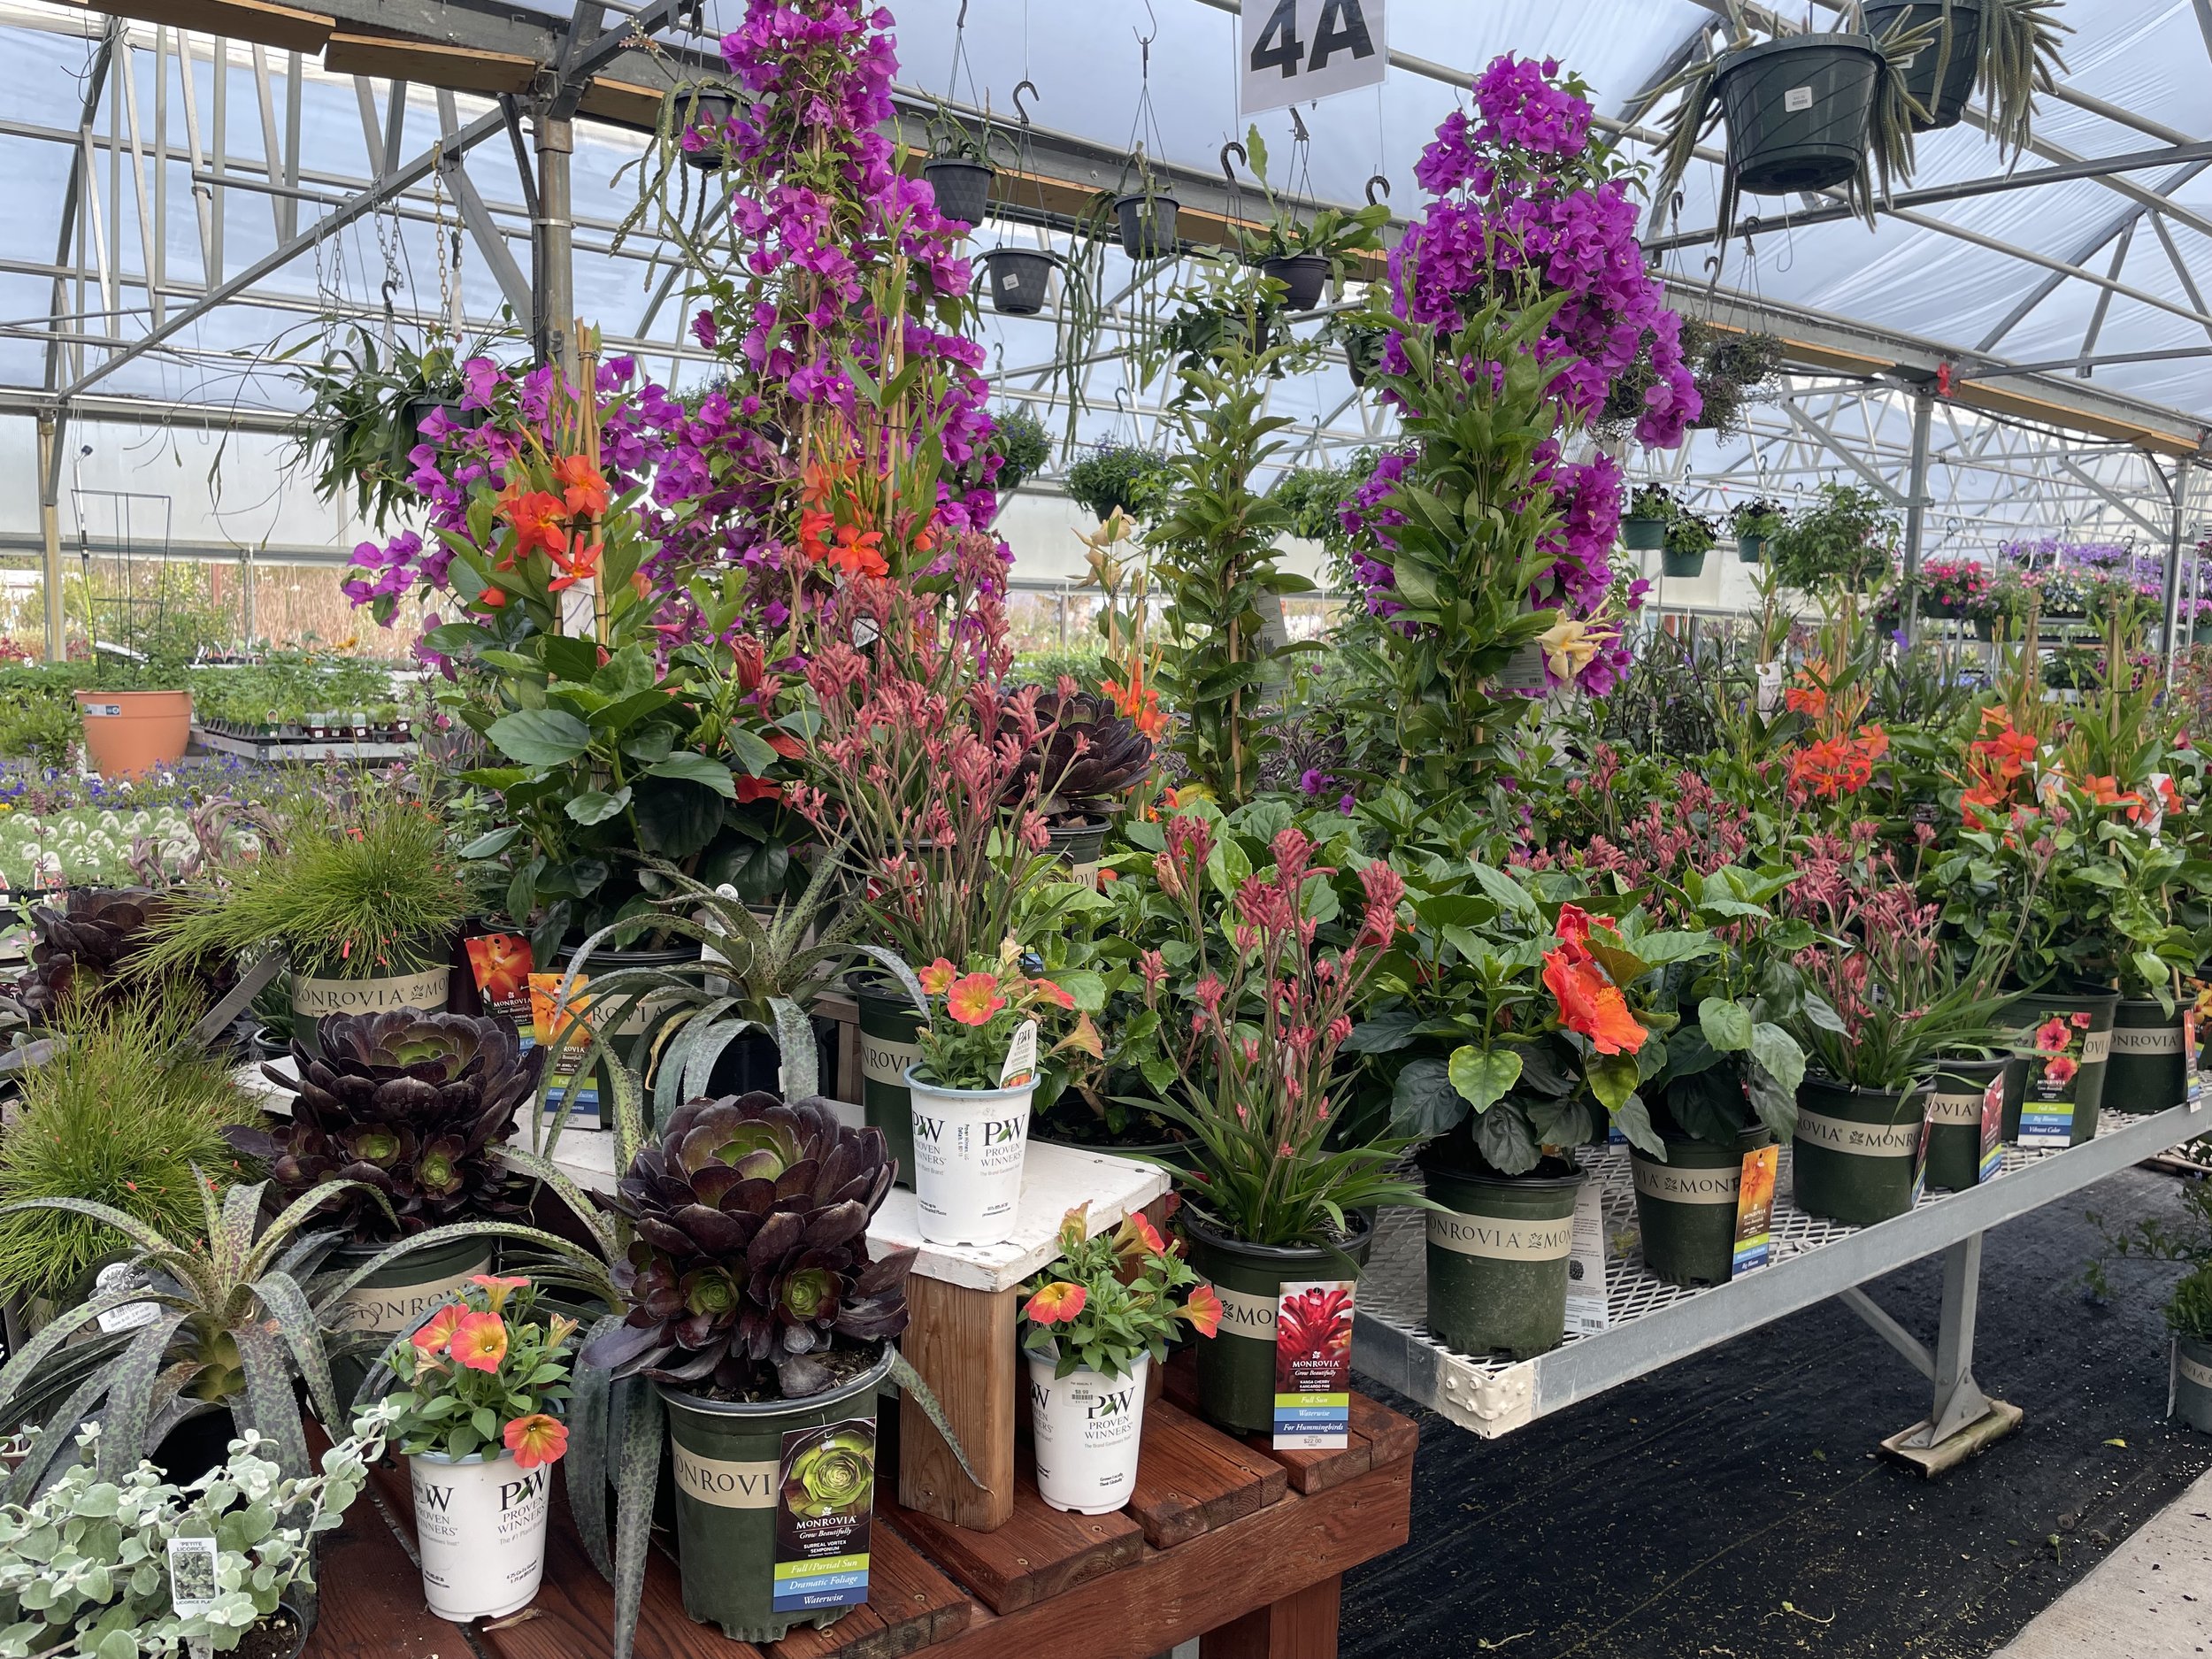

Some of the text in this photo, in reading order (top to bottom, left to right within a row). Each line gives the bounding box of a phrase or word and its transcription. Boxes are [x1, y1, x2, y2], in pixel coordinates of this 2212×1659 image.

[1250, 0, 1375, 79] 4A
[984, 1113, 1025, 1146] PW
[986, 1142, 1020, 1157] PROVEN
[980, 1151, 1021, 1166] WINNERS
[1085, 1386, 1135, 1419] PW
[1089, 1415, 1129, 1430] PROVEN
[1295, 1423, 1344, 1432] Hummingbirds
[1085, 1424, 1132, 1440] WINNERS
[498, 1463, 547, 1513] PW
[503, 1496, 543, 1523] PROVEN
[497, 1506, 545, 1535] WINNERS
[796, 1515, 856, 1530] MONROVIA
[818, 1527, 852, 1537] Beautifully
[789, 1575, 858, 1590] Dramatic Foliage
[803, 1594, 844, 1605] Waterwise
